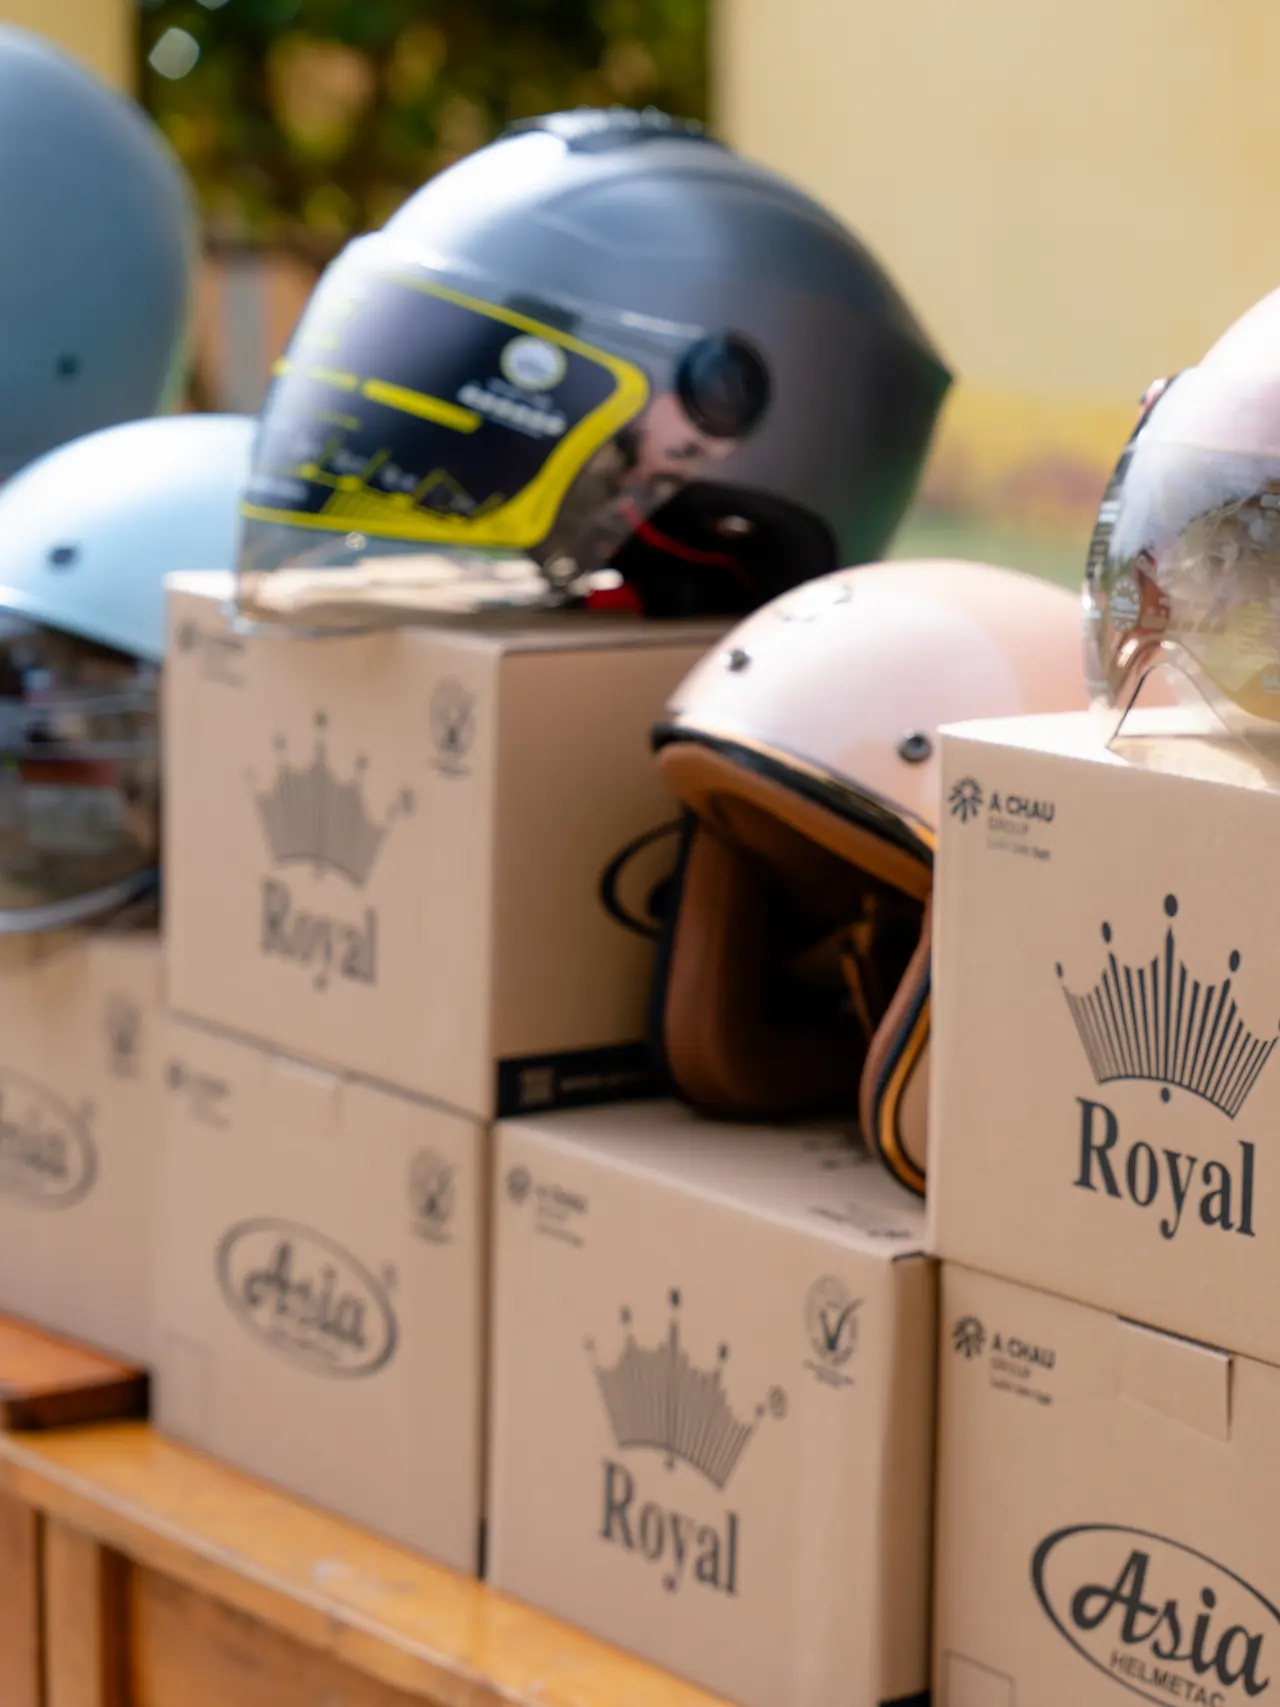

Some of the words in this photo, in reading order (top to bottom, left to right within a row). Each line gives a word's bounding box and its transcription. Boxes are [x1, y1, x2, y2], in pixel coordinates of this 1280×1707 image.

[1073, 1096, 1256, 1240] Royal
[600, 1457, 740, 1599] Royal
[1070, 1549, 1270, 1697] Asia
